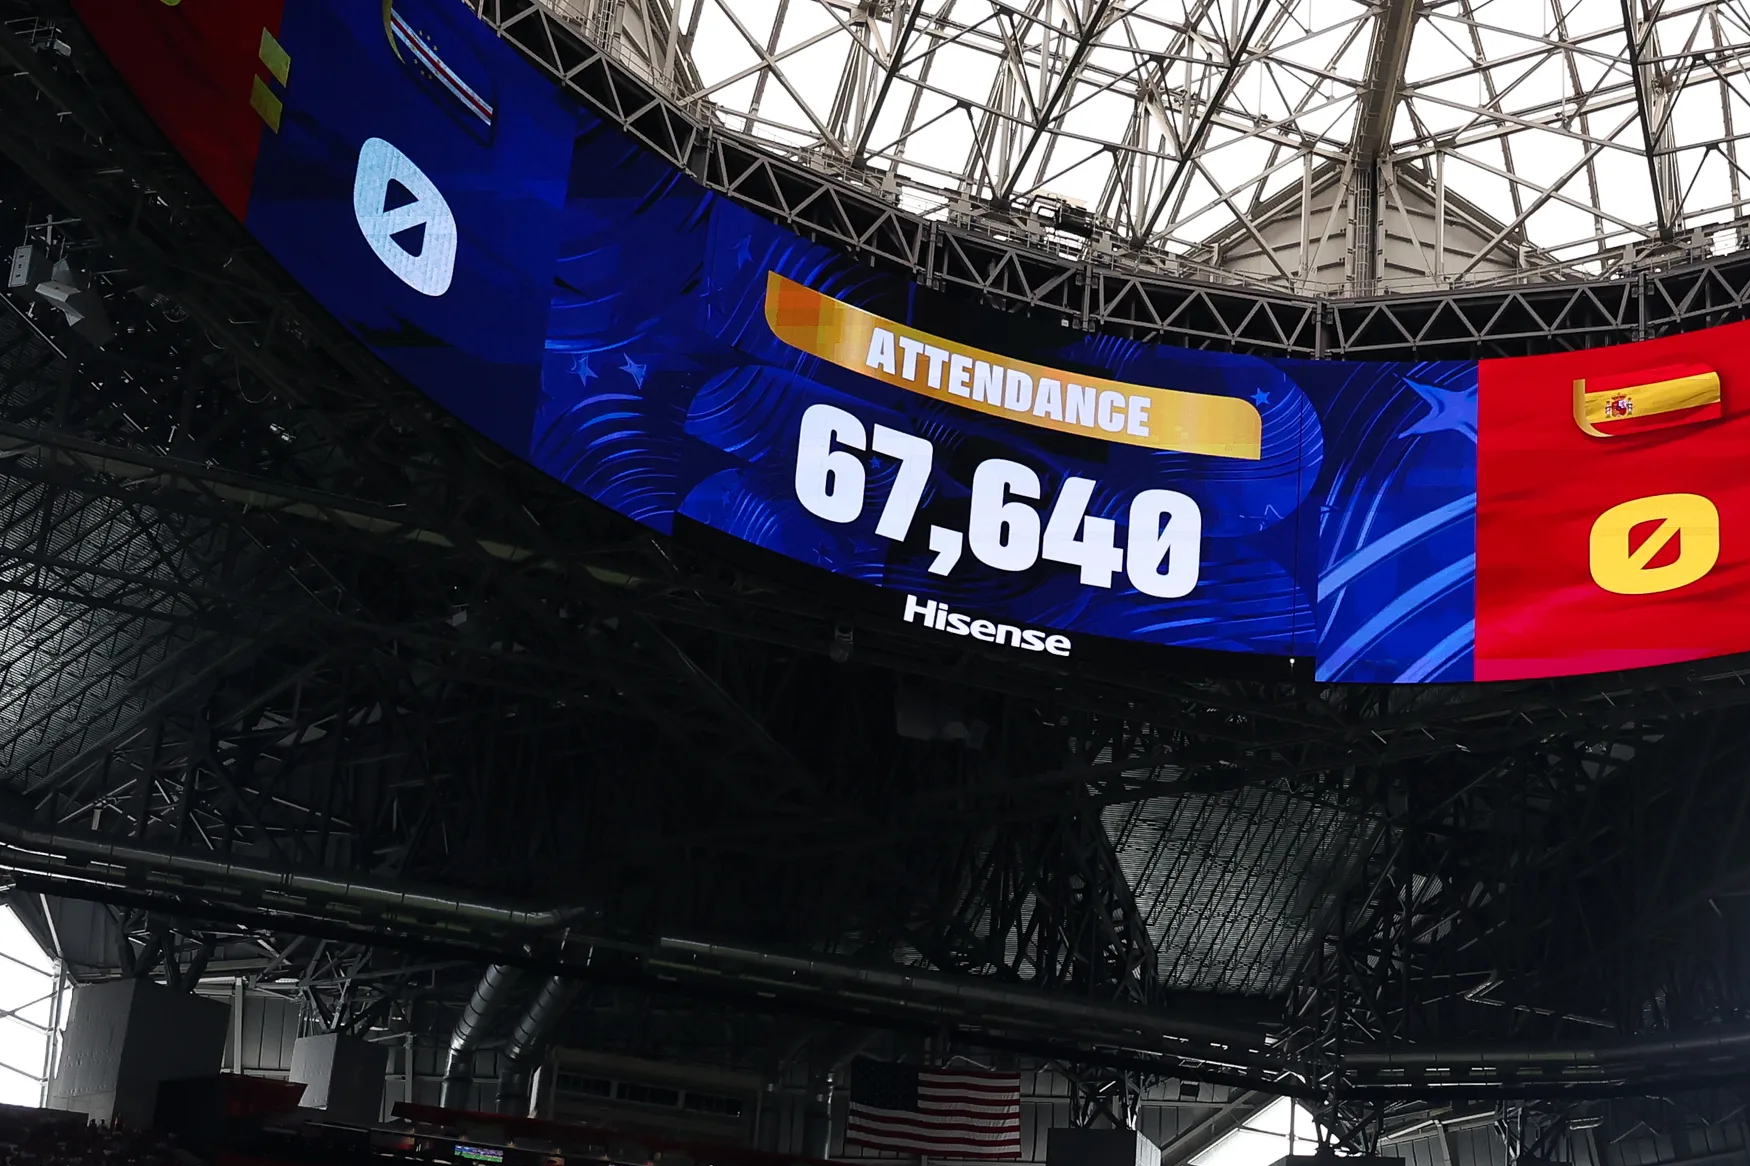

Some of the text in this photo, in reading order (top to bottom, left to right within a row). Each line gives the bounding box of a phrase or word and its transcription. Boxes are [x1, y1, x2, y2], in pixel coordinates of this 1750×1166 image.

[865, 327, 1152, 437] ATTENDANCE
[795, 403, 1201, 599] 67,640
[1589, 494, 1720, 595] 0
[903, 594, 1071, 656] Hisense
